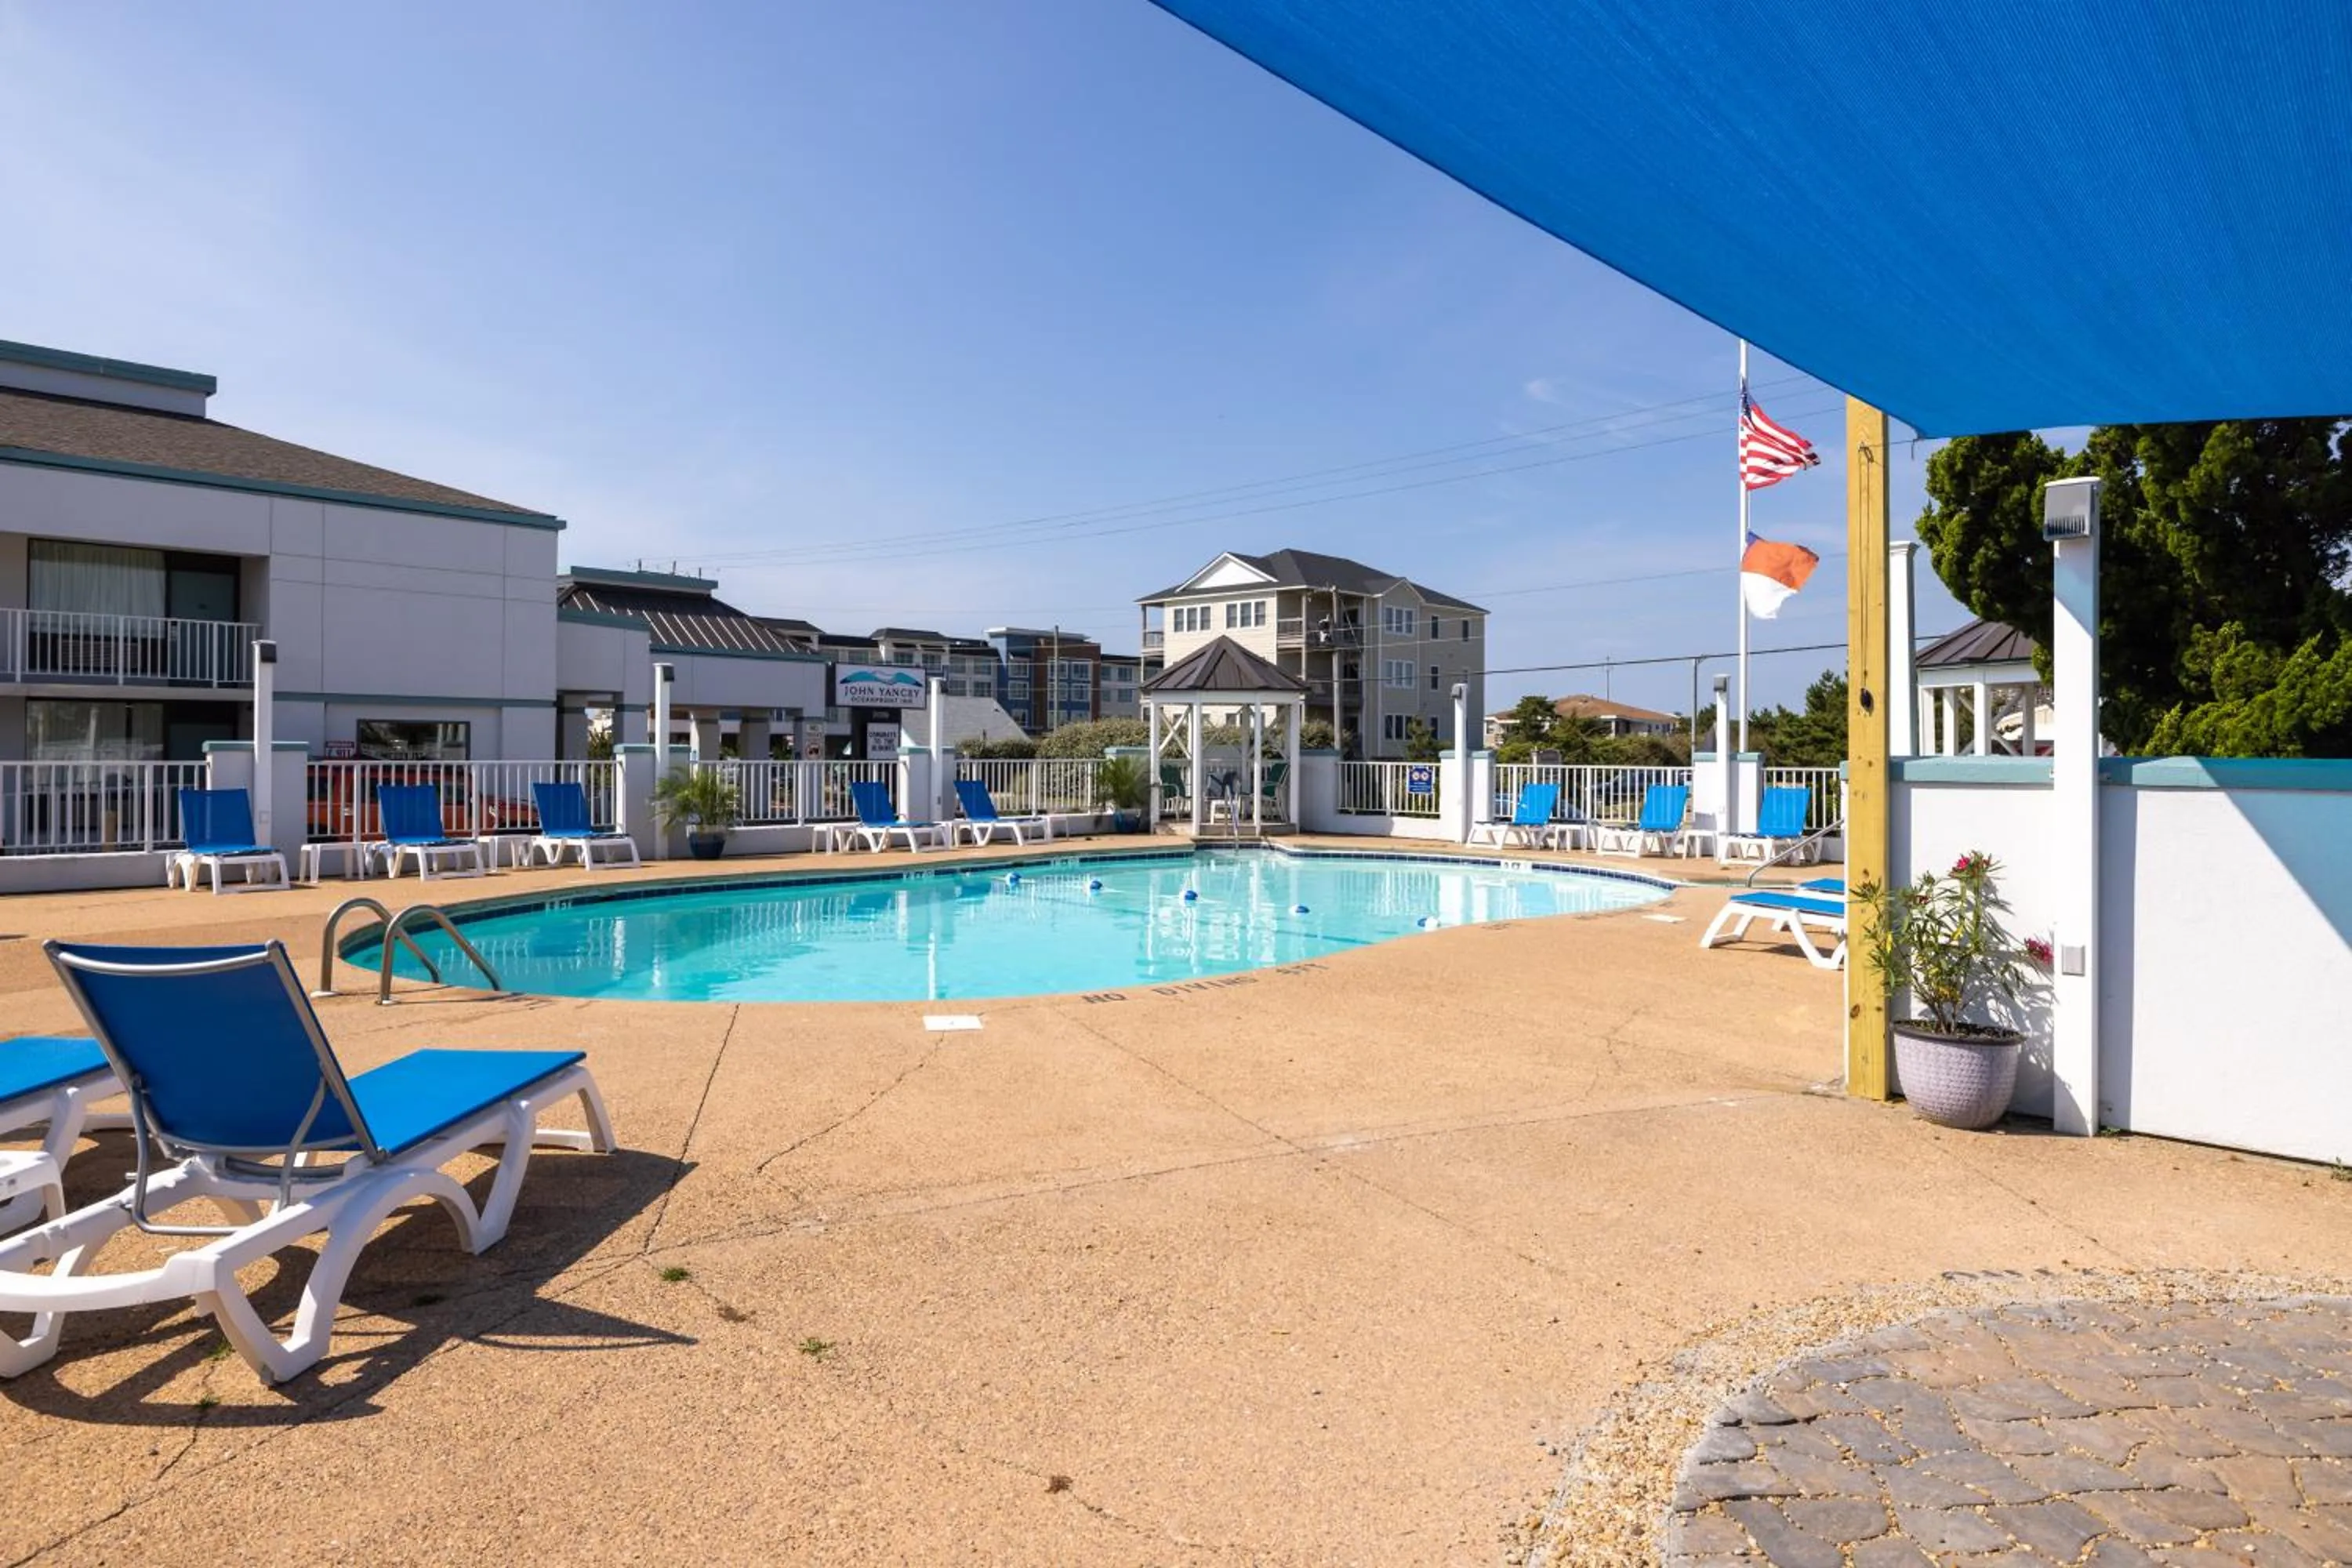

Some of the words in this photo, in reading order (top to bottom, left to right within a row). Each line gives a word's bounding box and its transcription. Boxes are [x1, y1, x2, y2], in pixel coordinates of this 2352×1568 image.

[844, 686, 874, 697] JOHN
[879, 687, 920, 698] YANCEY
[1082, 993, 1127, 1004] NO
[1152, 976, 1259, 996] DIVING
